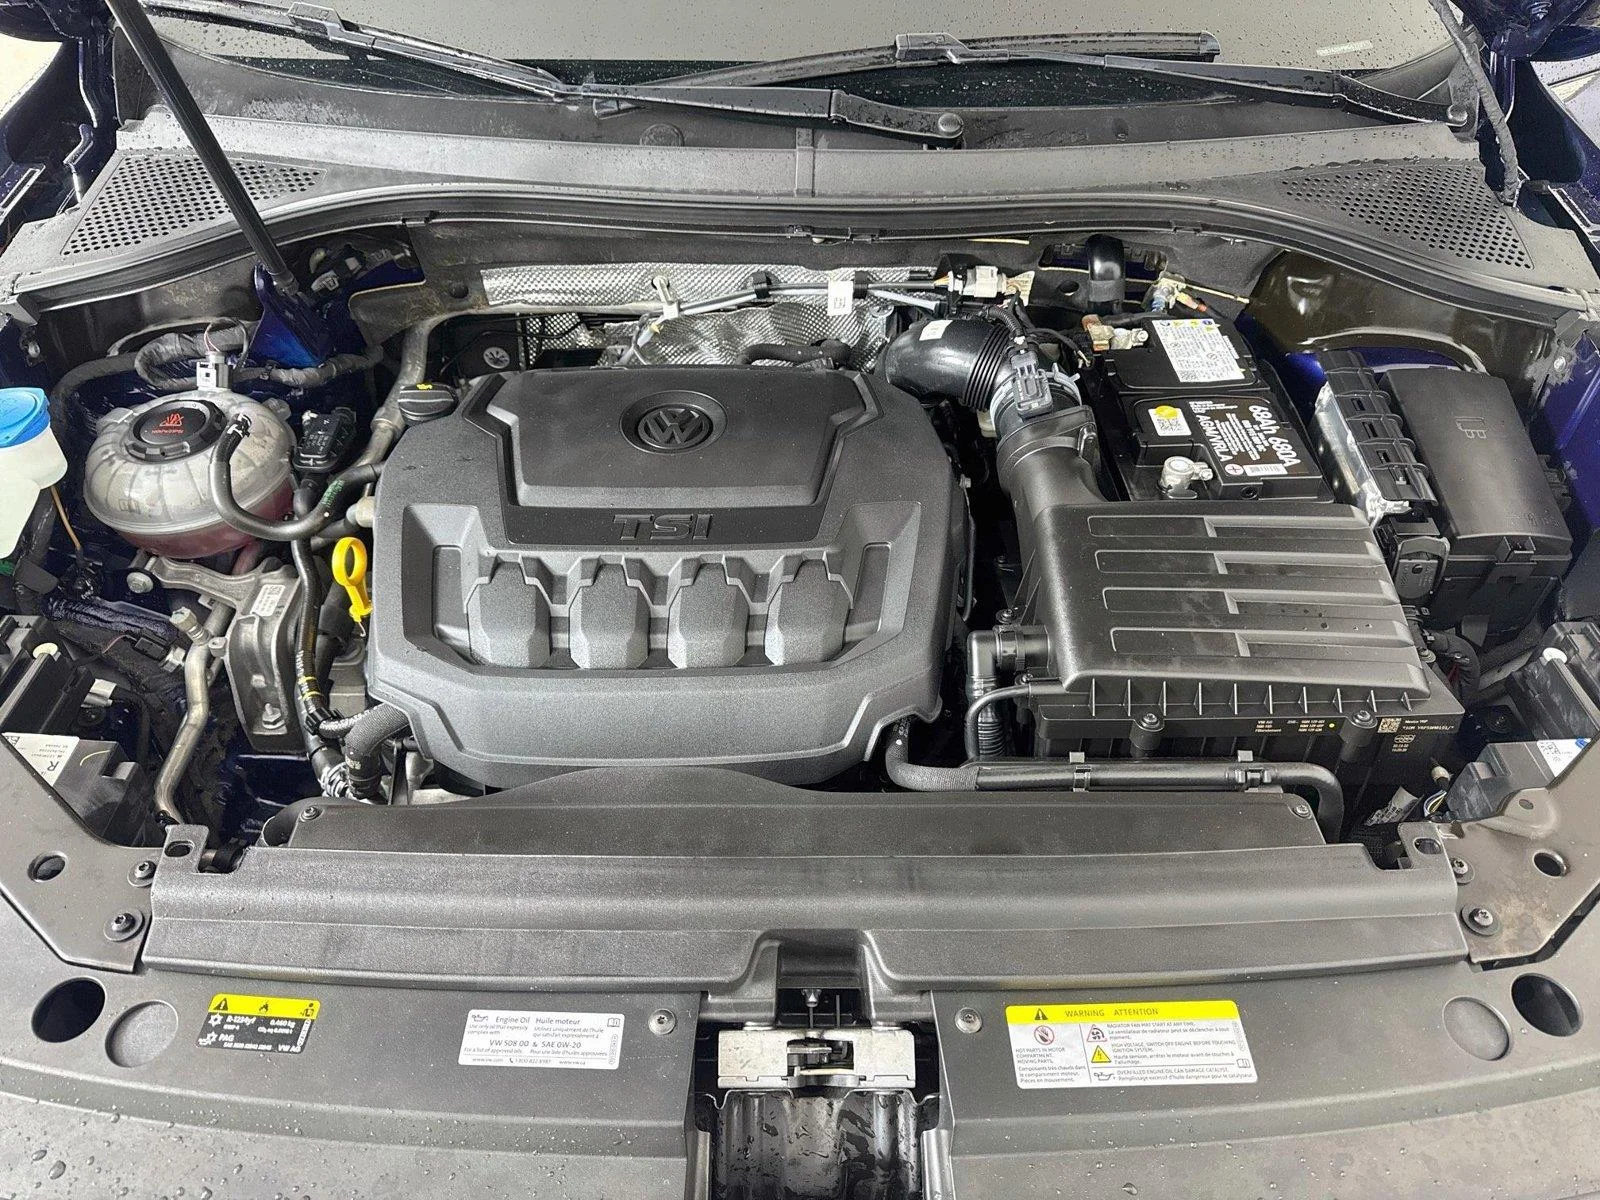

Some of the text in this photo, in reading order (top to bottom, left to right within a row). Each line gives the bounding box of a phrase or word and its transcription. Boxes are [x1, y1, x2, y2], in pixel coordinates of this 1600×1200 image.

[638, 403, 712, 450] VW
[1249, 405, 1280, 434] 68Ah
[1268, 436, 1301, 467] 680A
[613, 514, 713, 540] TSI
[496, 1016, 518, 1024] Engine
